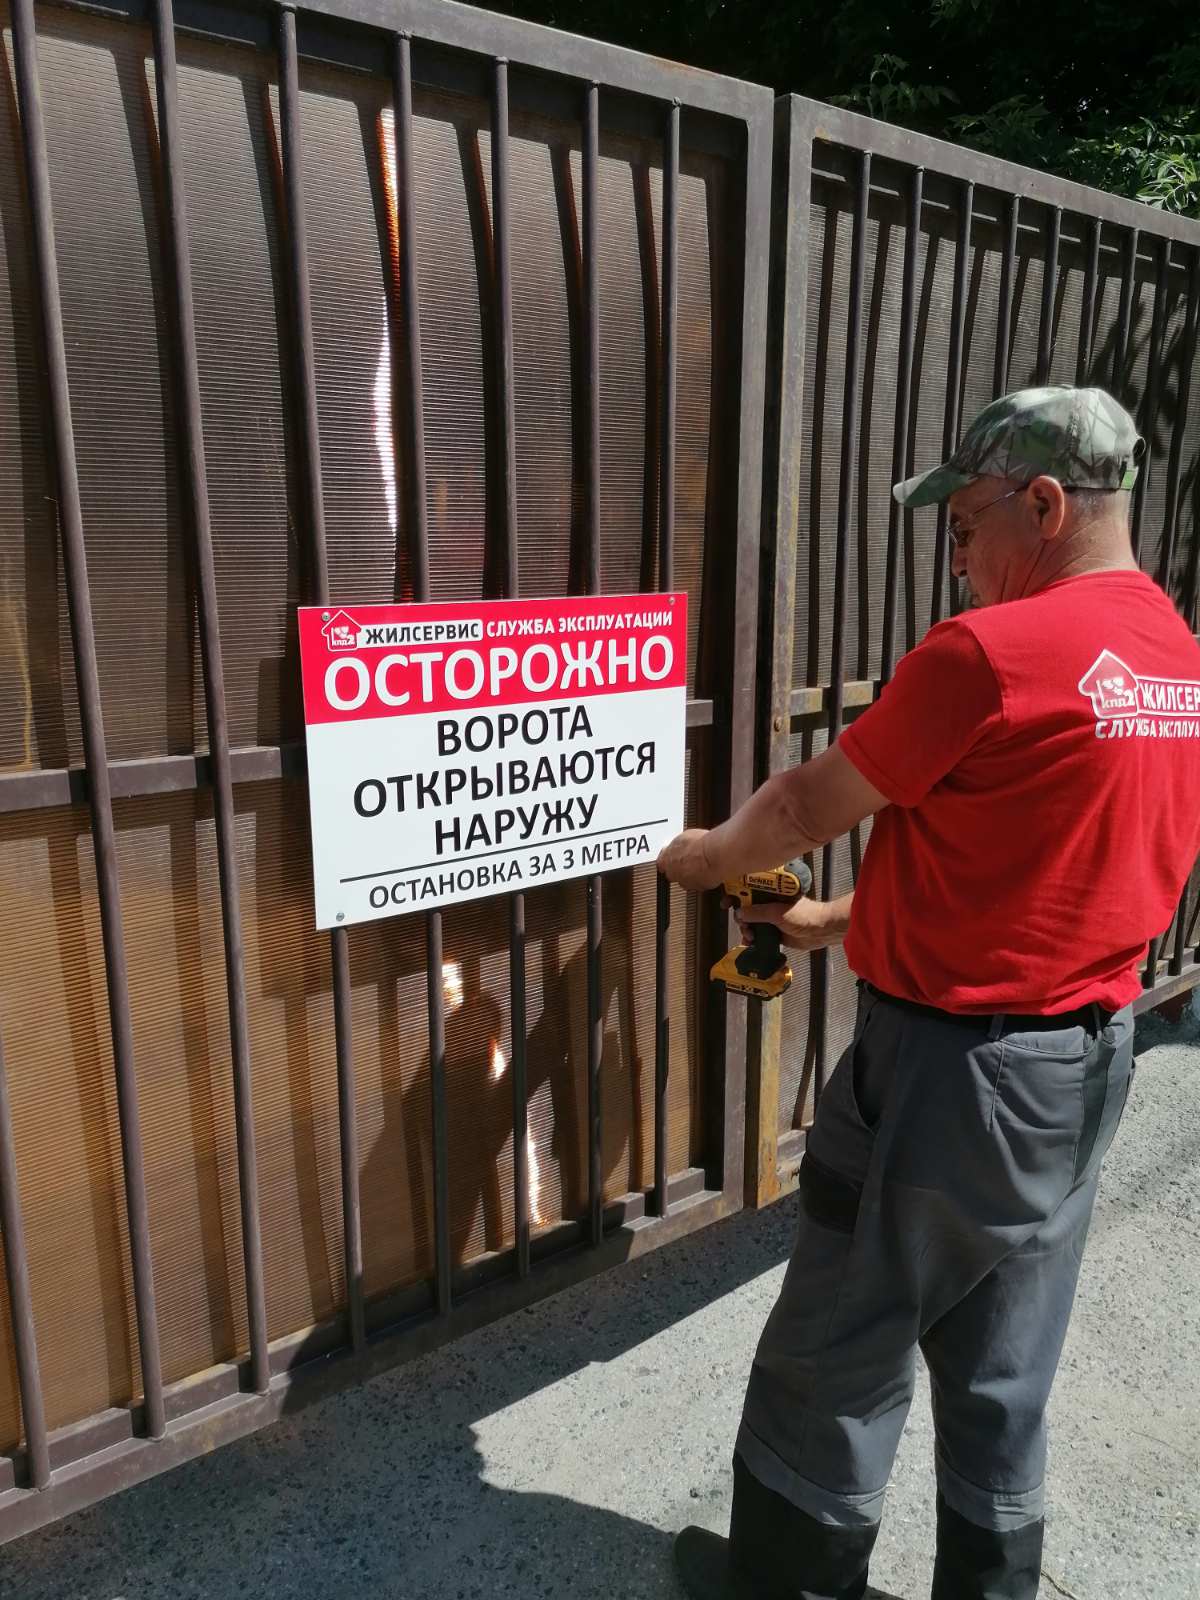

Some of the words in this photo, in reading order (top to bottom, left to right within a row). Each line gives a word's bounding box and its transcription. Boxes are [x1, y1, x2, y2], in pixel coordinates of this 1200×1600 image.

[365, 623, 479, 644] ЖИЛСЕРВИС
[486, 618, 555, 637] СЛУЖБА
[558, 611, 672, 632] ЭКСПЛУАТАЦИИ
[324, 635, 673, 711] ОСТОРОЖНО
[437, 704, 592, 756] ВОРОТА
[1095, 718, 1157, 739] СЛУЖБА
[353, 742, 656, 818] ОТКРЫВАЮТСЯ
[435, 794, 598, 855] НАРУЖУ
[369, 860, 522, 909] ОСТАНОВКА
[529, 853, 556, 877] ЗА
[563, 849, 575, 869] 3
[581, 834, 650, 866] МЕТРА
